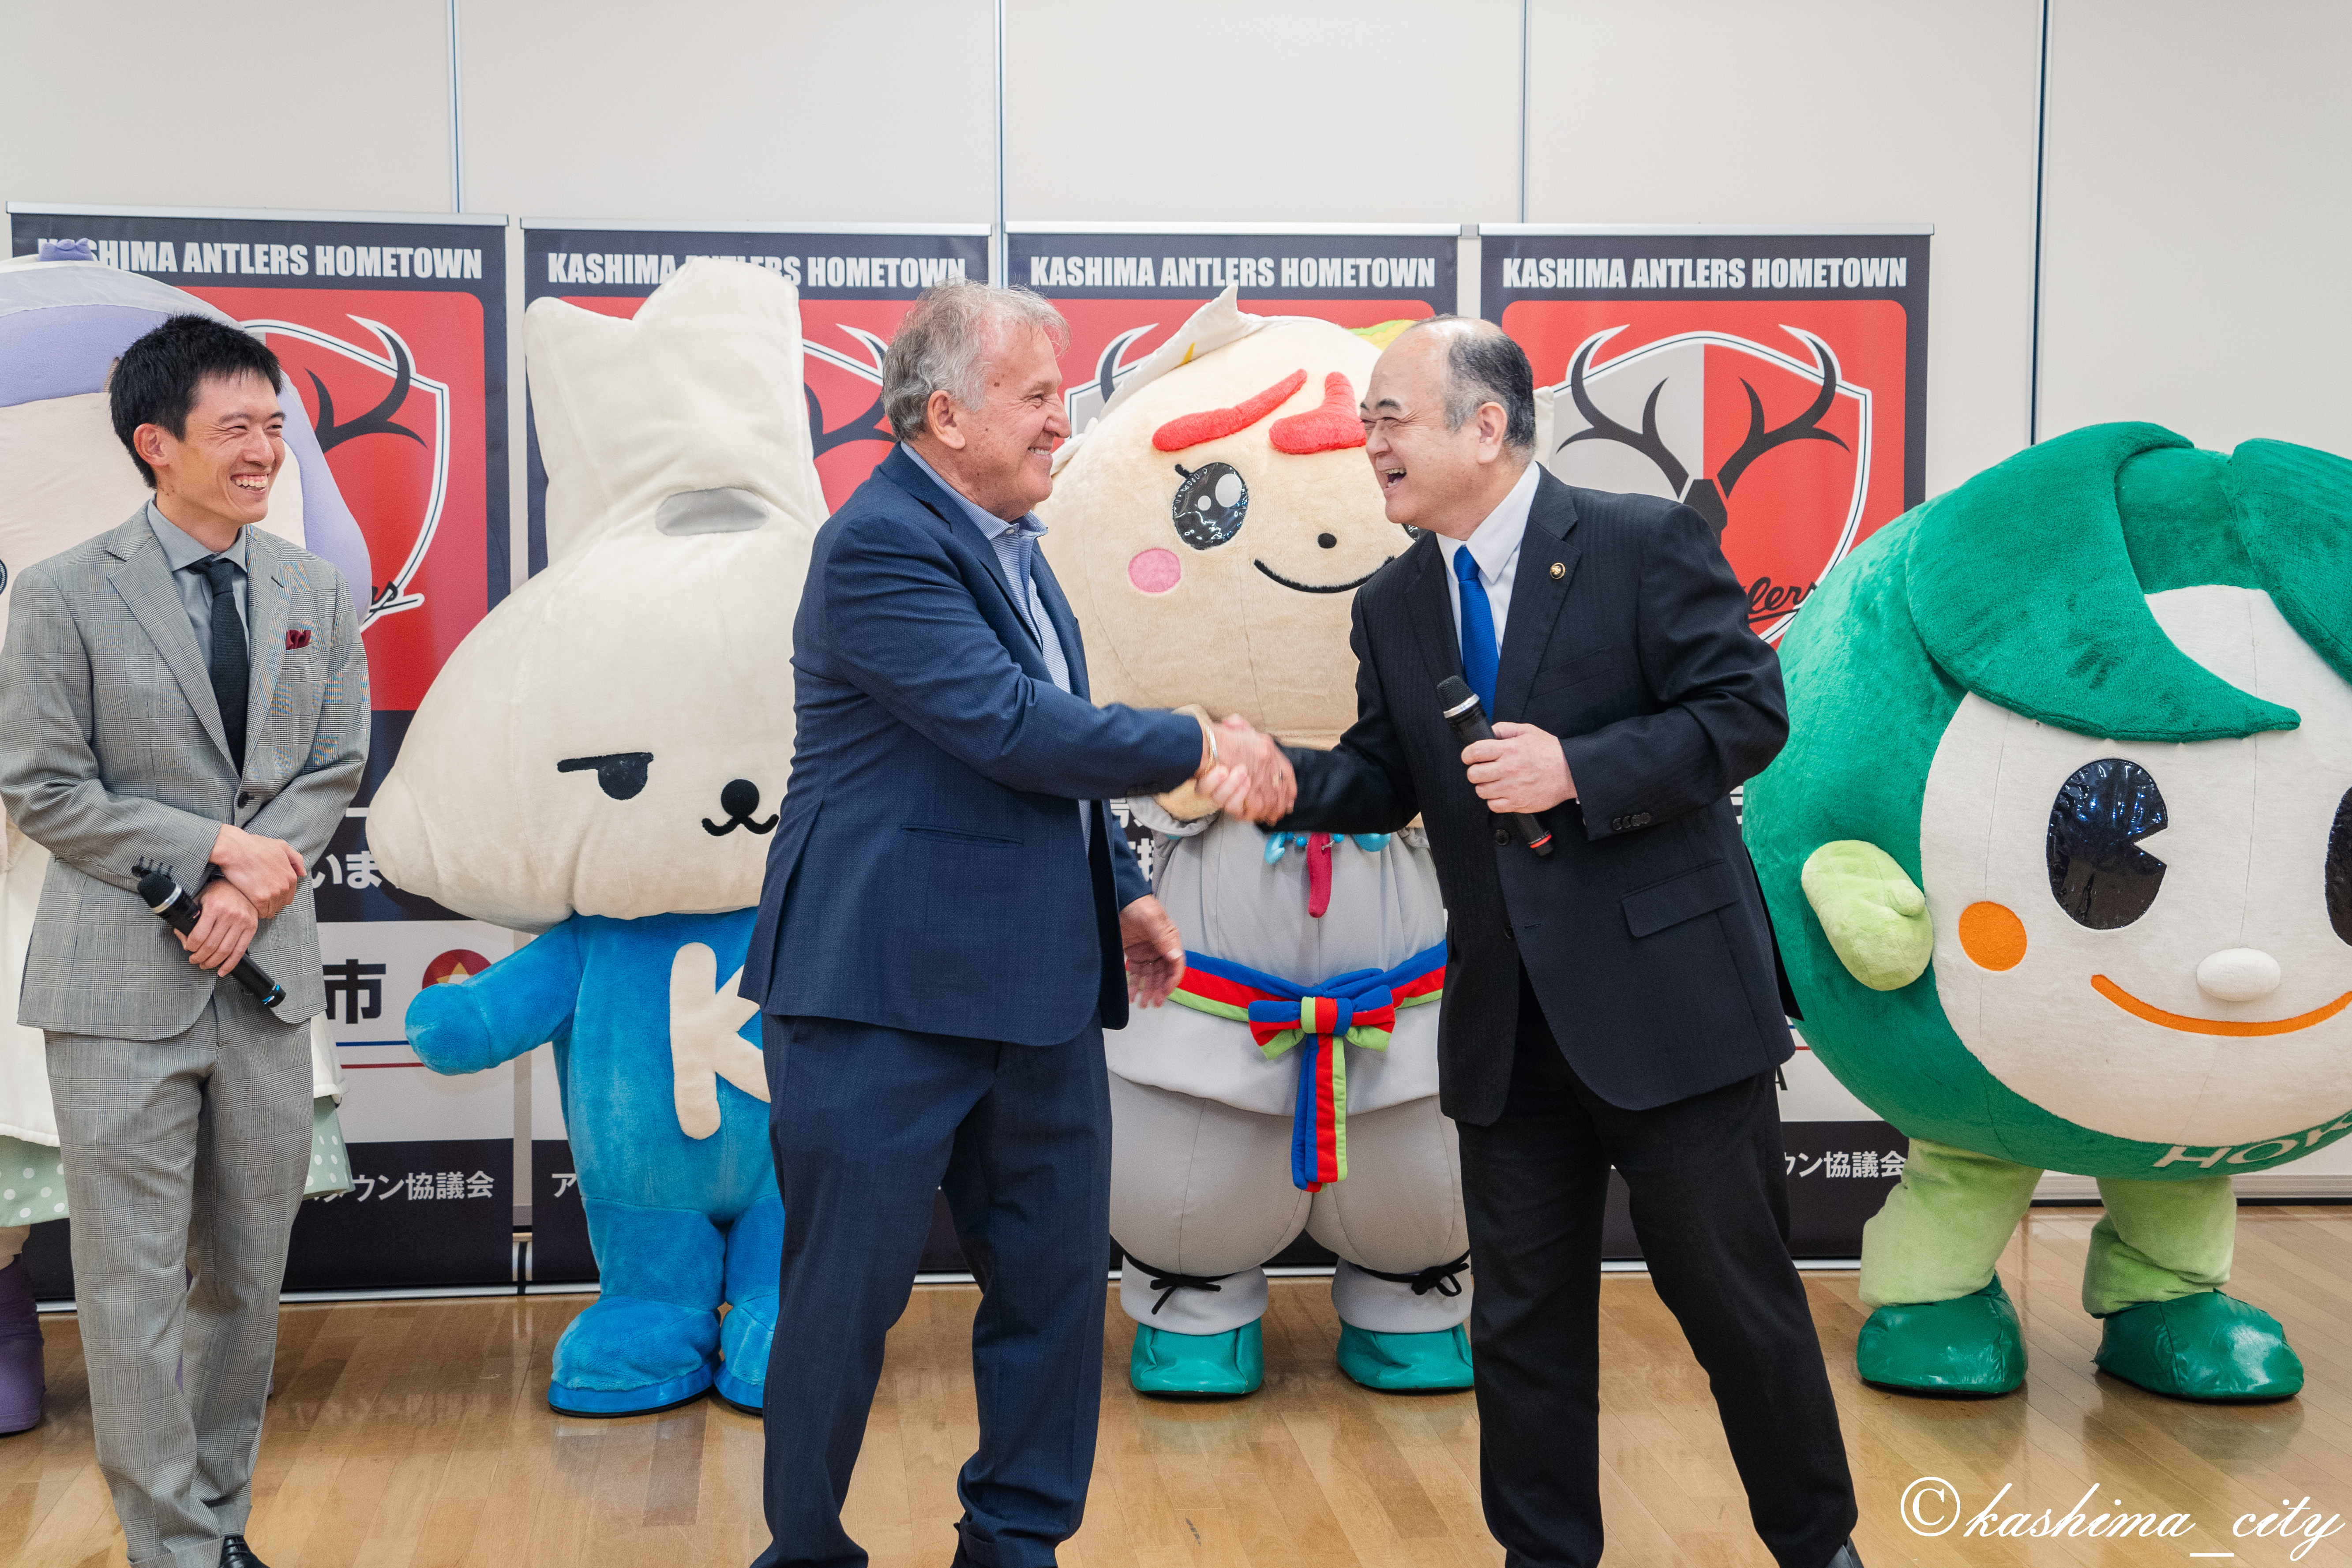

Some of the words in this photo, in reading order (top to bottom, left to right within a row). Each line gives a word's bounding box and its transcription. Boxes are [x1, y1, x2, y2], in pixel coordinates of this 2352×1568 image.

[38, 238, 177, 273] HIMA
[183, 242, 309, 276] ANTLERS
[315, 245, 482, 279] HOMETOWN
[548, 253, 676, 284] KASHIMA
[807, 256, 965, 288] HOMETOWN
[1030, 256, 1155, 288] KASHIMA
[1160, 257, 1275, 288] ANTLERS
[1281, 257, 1435, 288] HOMETOWN
[1503, 258, 1627, 289] KASHIMA
[1631, 258, 1746, 288] ANTLERS
[1752, 257, 1907, 288] HOMETOWN
[323, 959, 386, 1024] 市
[315, 1170, 495, 1203] ウン協議会
